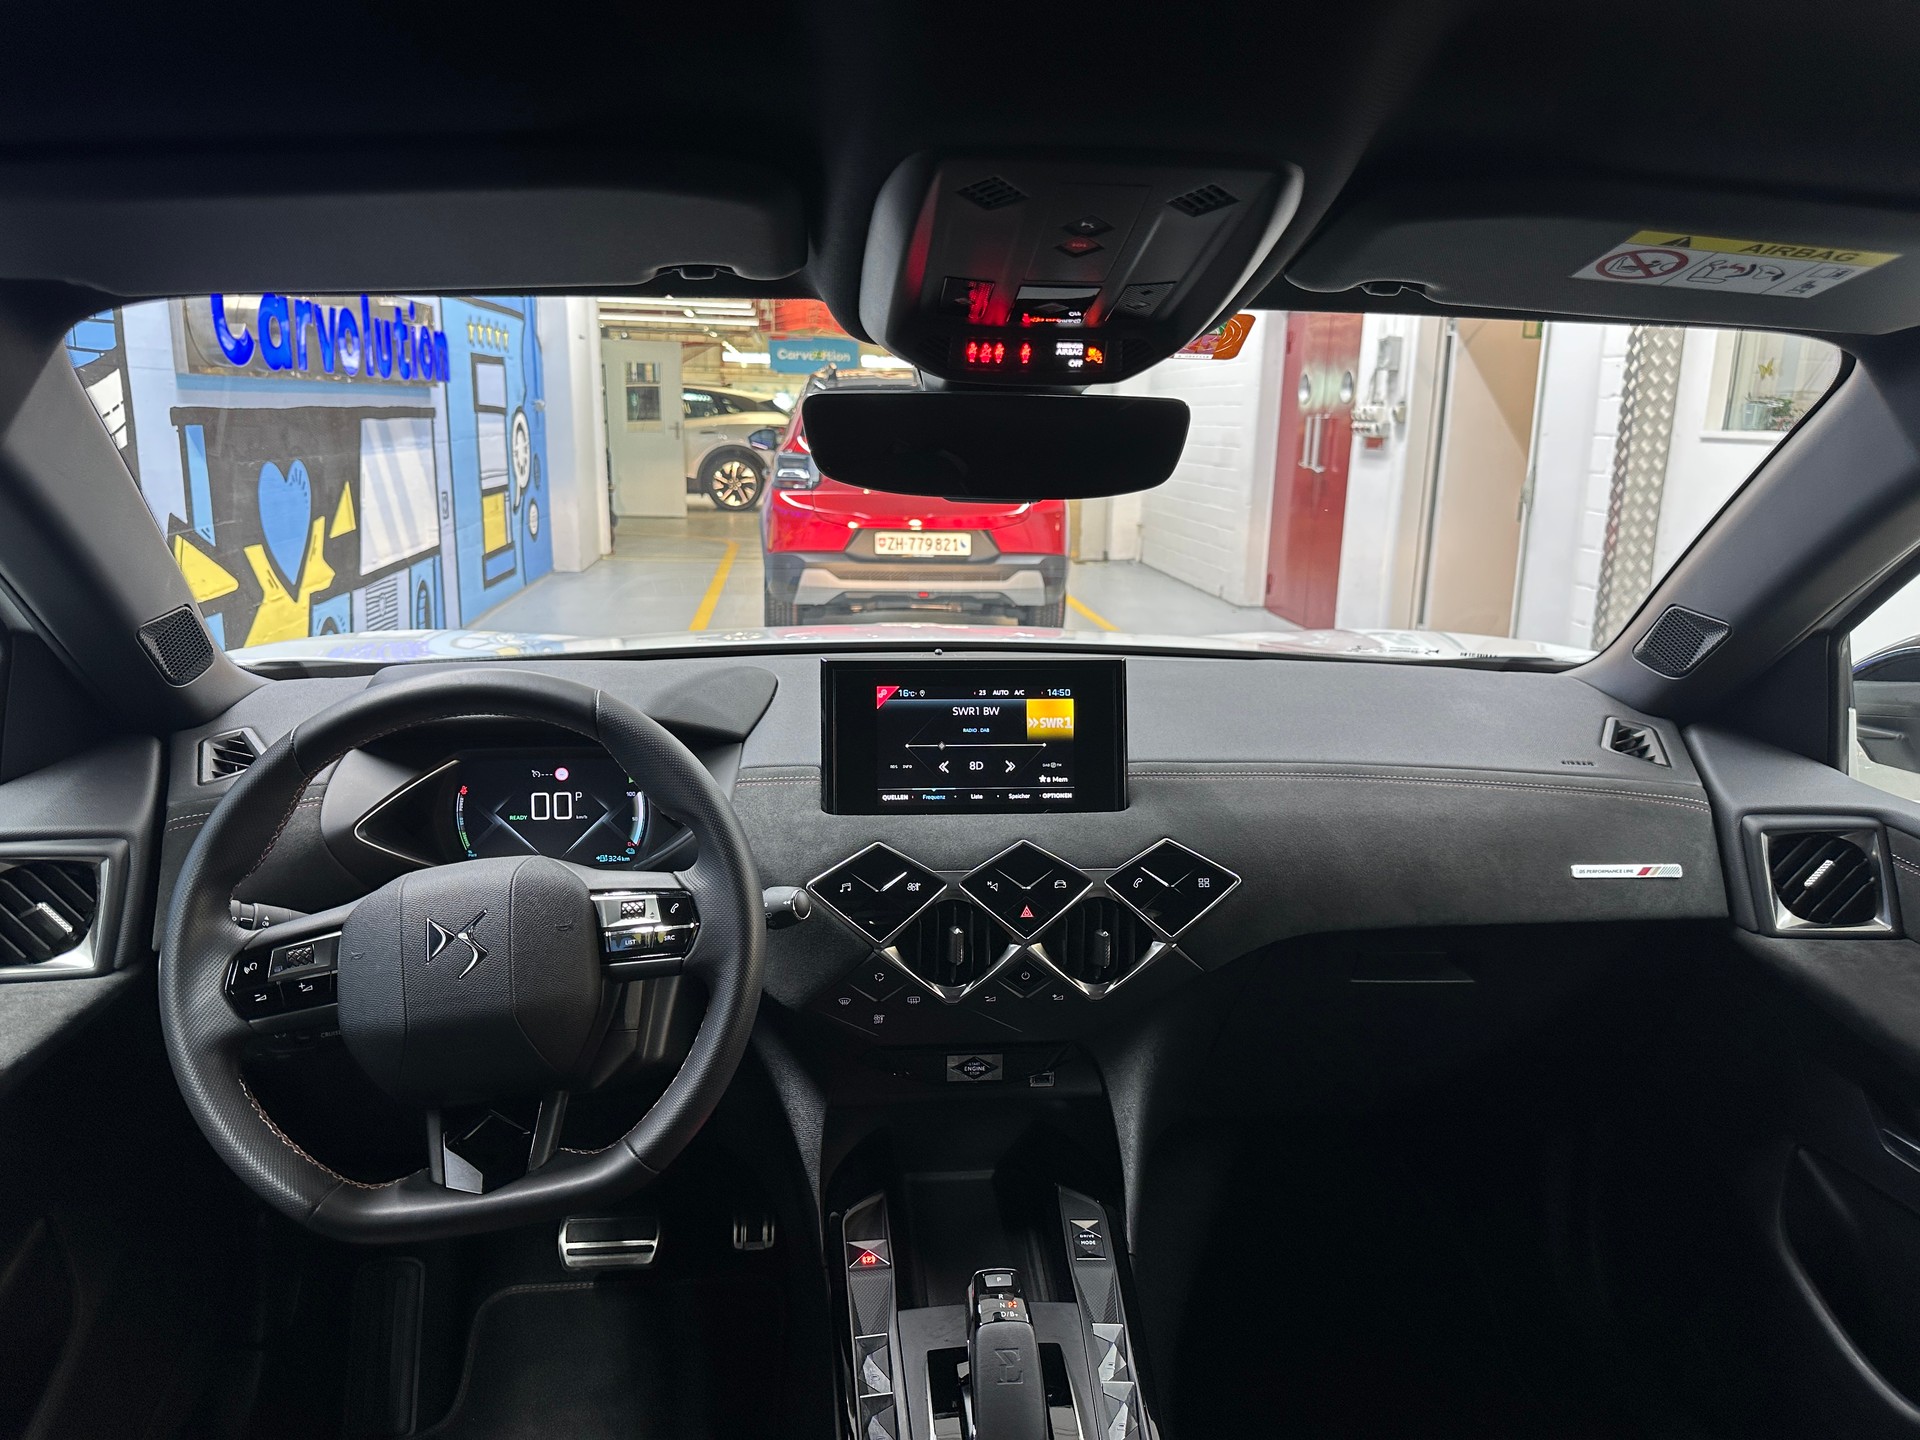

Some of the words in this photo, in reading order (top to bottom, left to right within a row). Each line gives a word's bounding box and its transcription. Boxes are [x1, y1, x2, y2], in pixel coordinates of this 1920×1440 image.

[1739, 243, 1860, 262] AIRBAG
[210, 293, 450, 383] Carvolution
[1068, 359, 1083, 367] OFF
[1046, 688, 1071, 696] 14:50
[952, 706, 979, 716] SWR1
[983, 706, 1000, 716] BW
[968, 761, 984, 770] 8D
[575, 791, 583, 802] P
[881, 794, 909, 802] QUELLEN
